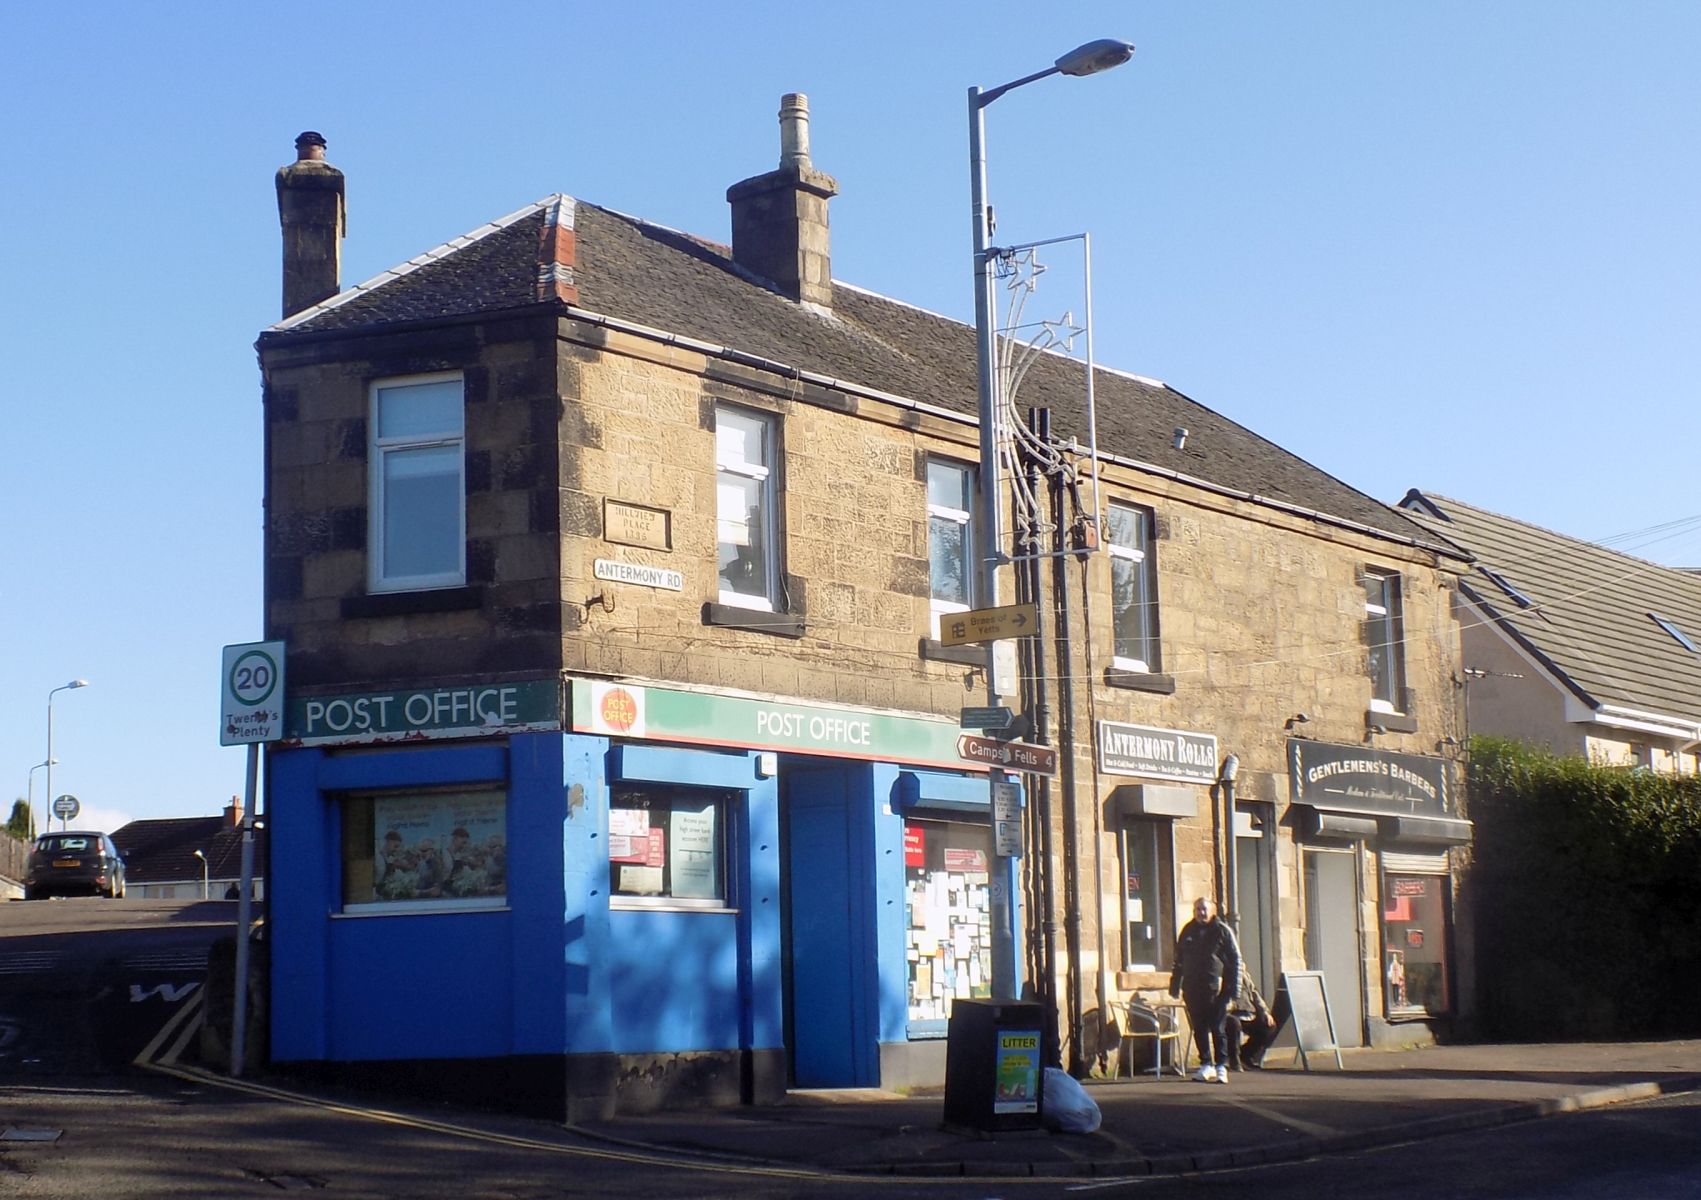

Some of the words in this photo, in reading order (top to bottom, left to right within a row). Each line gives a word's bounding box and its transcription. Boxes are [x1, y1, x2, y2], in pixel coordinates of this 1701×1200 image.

[623, 518, 650, 531] PLACE
[598, 562, 663, 585] ANTERMONY
[667, 573, 681, 588] RD
[237, 666, 269, 690] 20
[306, 696, 394, 733] POST
[404, 687, 517, 725] OFFICE
[607, 696, 630, 710] POST
[603, 710, 633, 724] OFFICE
[232, 725, 270, 738] Plenty
[757, 710, 805, 738] POST
[809, 716, 871, 745] OFFICE
[1014, 749, 1038, 765] Fells
[1045, 755, 1053, 768] 4
[1390, 763, 1437, 799] BARBERS
[1002, 1036, 1037, 1049] LITTER
